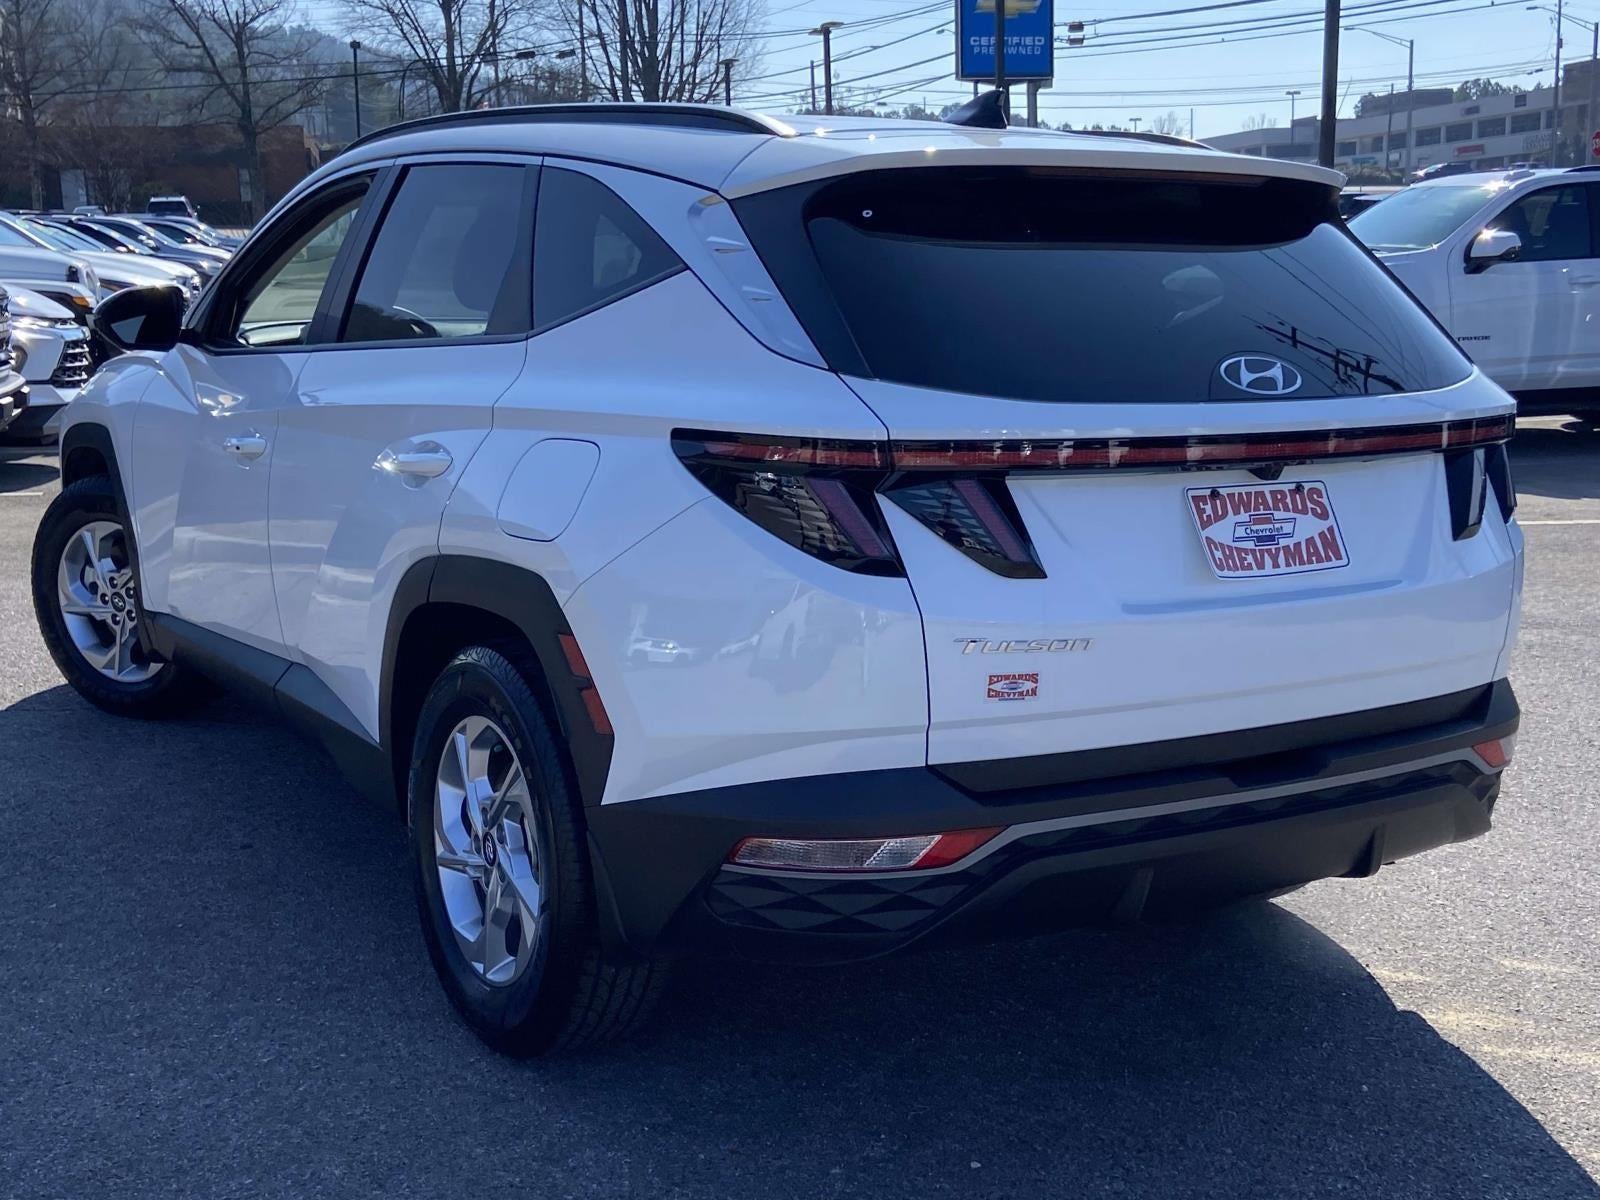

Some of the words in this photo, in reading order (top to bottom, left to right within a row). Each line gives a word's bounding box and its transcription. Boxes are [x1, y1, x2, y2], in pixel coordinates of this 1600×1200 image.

[1190, 487, 1330, 531] EDWARDS
[1244, 525, 1284, 536] Chevrolet
[1205, 524, 1343, 573] CHEVYMAN
[988, 673, 1039, 686] EDWARDS
[987, 685, 1038, 698] CHEVYMAN
